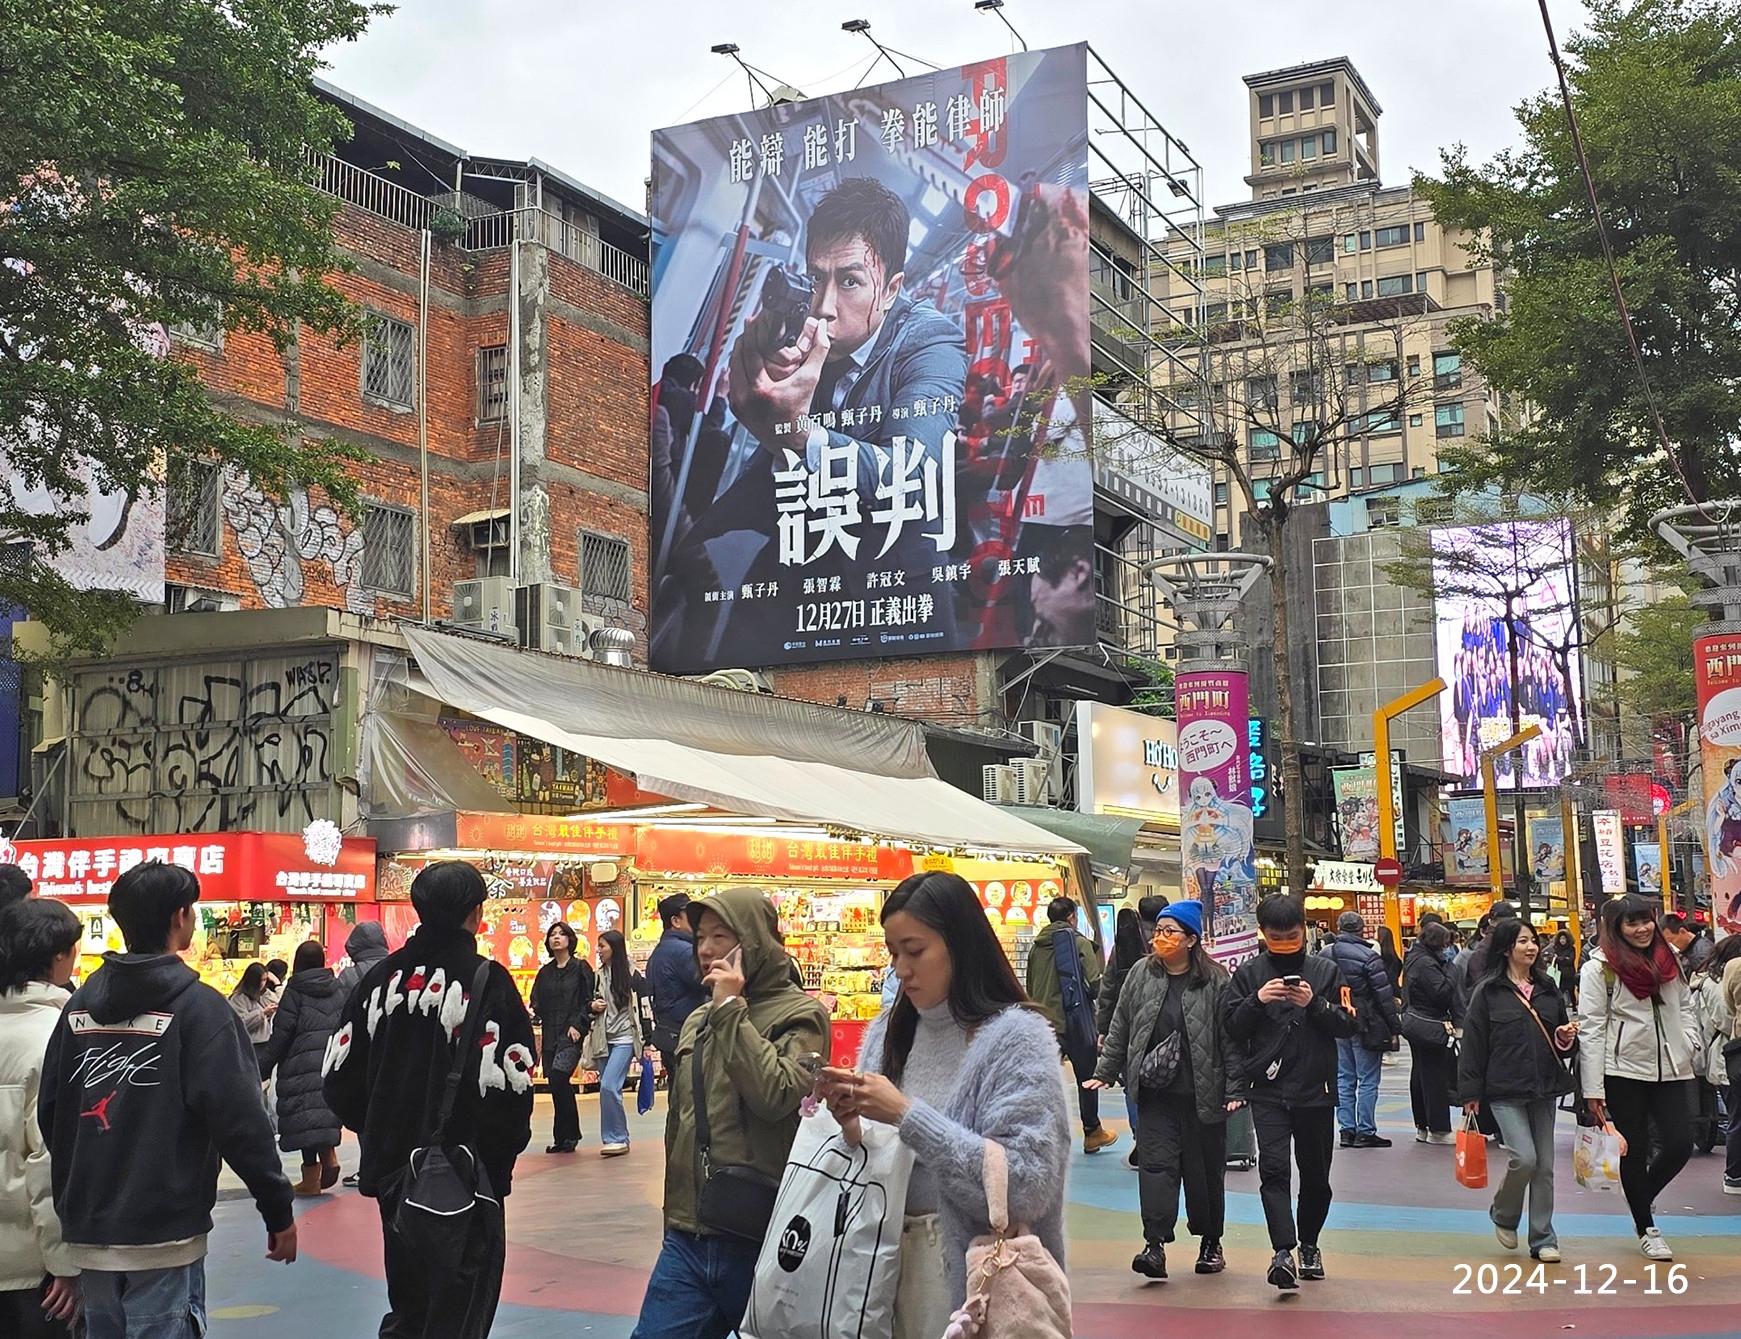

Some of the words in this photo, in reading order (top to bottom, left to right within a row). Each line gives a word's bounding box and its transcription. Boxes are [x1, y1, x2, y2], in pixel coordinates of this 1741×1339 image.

[729, 132, 785, 184] 能辯
[803, 117, 860, 171] 能打
[880, 86, 1006, 154] 拳能律師
[841, 405, 882, 427] 甄子丹
[913, 395, 956, 418] 甄子丹
[773, 429, 957, 567] 誤判
[741, 581, 779, 599] 甄子丹
[803, 575, 842, 595] 張智霖
[866, 569, 906, 589] 許冠文
[931, 563, 972, 583] 吳鎮宇
[998, 556, 1041, 576] 張天賦
[796, 599, 865, 632] 12月27日
[869, 594, 934, 626] 正義出拳
[1179, 690, 1230, 712] 西門町
[1710, 731, 1720, 741] sa
[1186, 741, 1233, 764] 西門町へ
[532, 823, 618, 840] 台灣最佳伴手禮
[787, 840, 878, 863] 台灣最佳伴手禮
[1385, 891, 1397, 900] 12
[75, 1016, 164, 1031] NKE
[68, 1041, 162, 1089] Flight
